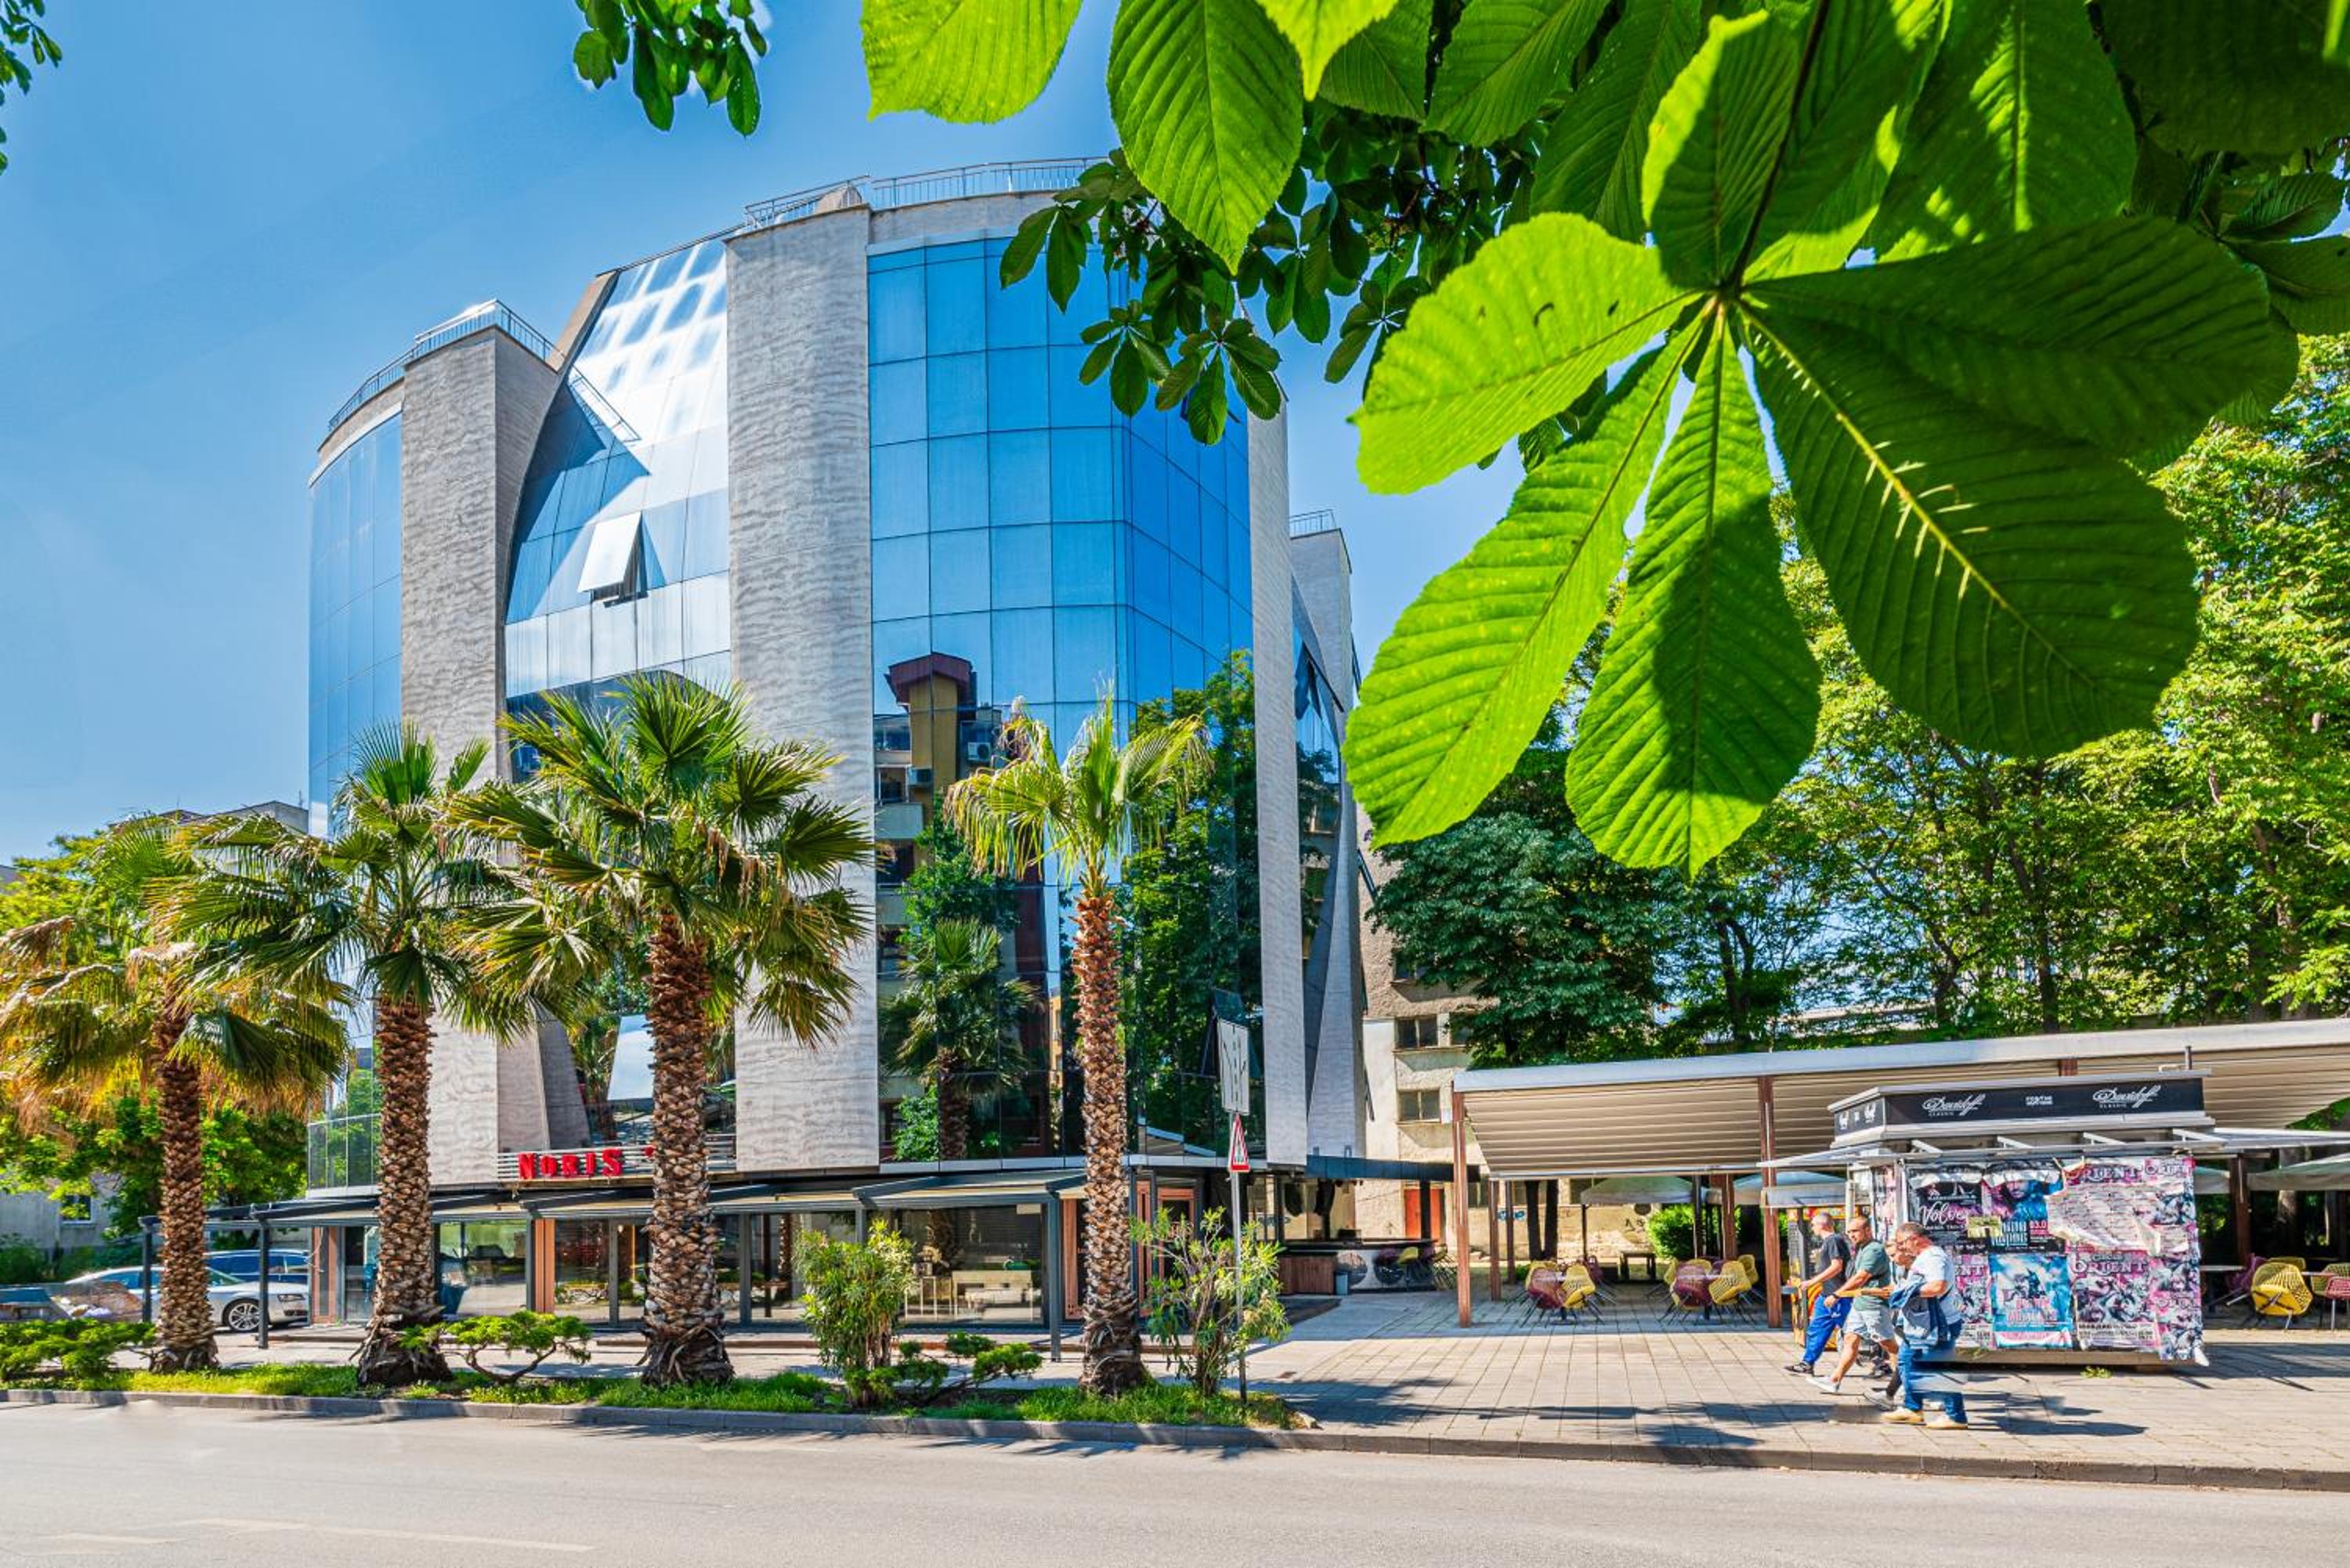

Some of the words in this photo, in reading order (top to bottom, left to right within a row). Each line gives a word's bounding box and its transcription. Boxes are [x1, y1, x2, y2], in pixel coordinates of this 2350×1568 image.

[1922, 1093, 1987, 1116] Davidoff
[2092, 1085, 2162, 1108] Davidoff
[2071, 1252, 2147, 1276] ORIENT
